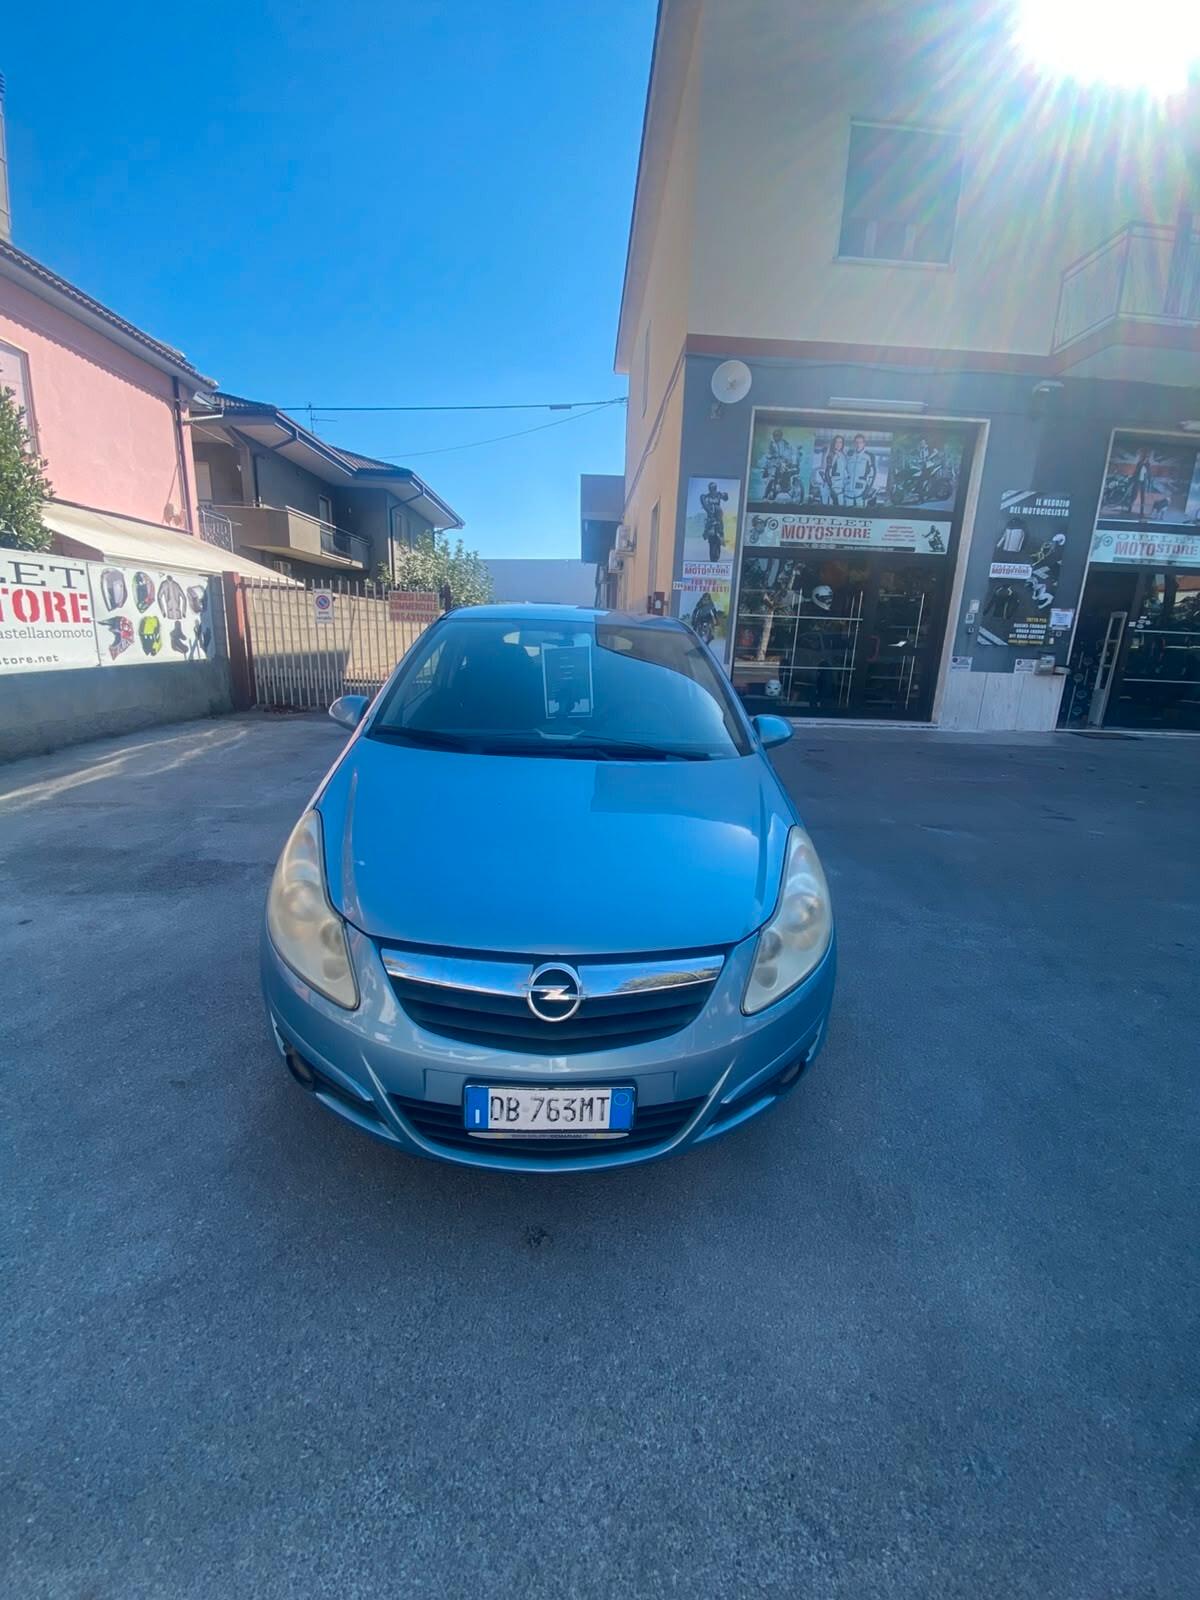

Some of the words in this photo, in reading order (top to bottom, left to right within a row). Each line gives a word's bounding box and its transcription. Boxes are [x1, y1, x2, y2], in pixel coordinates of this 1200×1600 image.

[1022, 507, 1069, 517] MOTOCICLISTA
[782, 516, 872, 527] OUTLET
[781, 525, 871, 541] MOTOSTORE
[1114, 541, 1198, 557] MOTOSTORE
[0, 561, 84, 589] ET
[0, 655, 59, 665] tore.net
[490, 1096, 520, 1122] DB
[530, 1096, 610, 1122] 763MT
